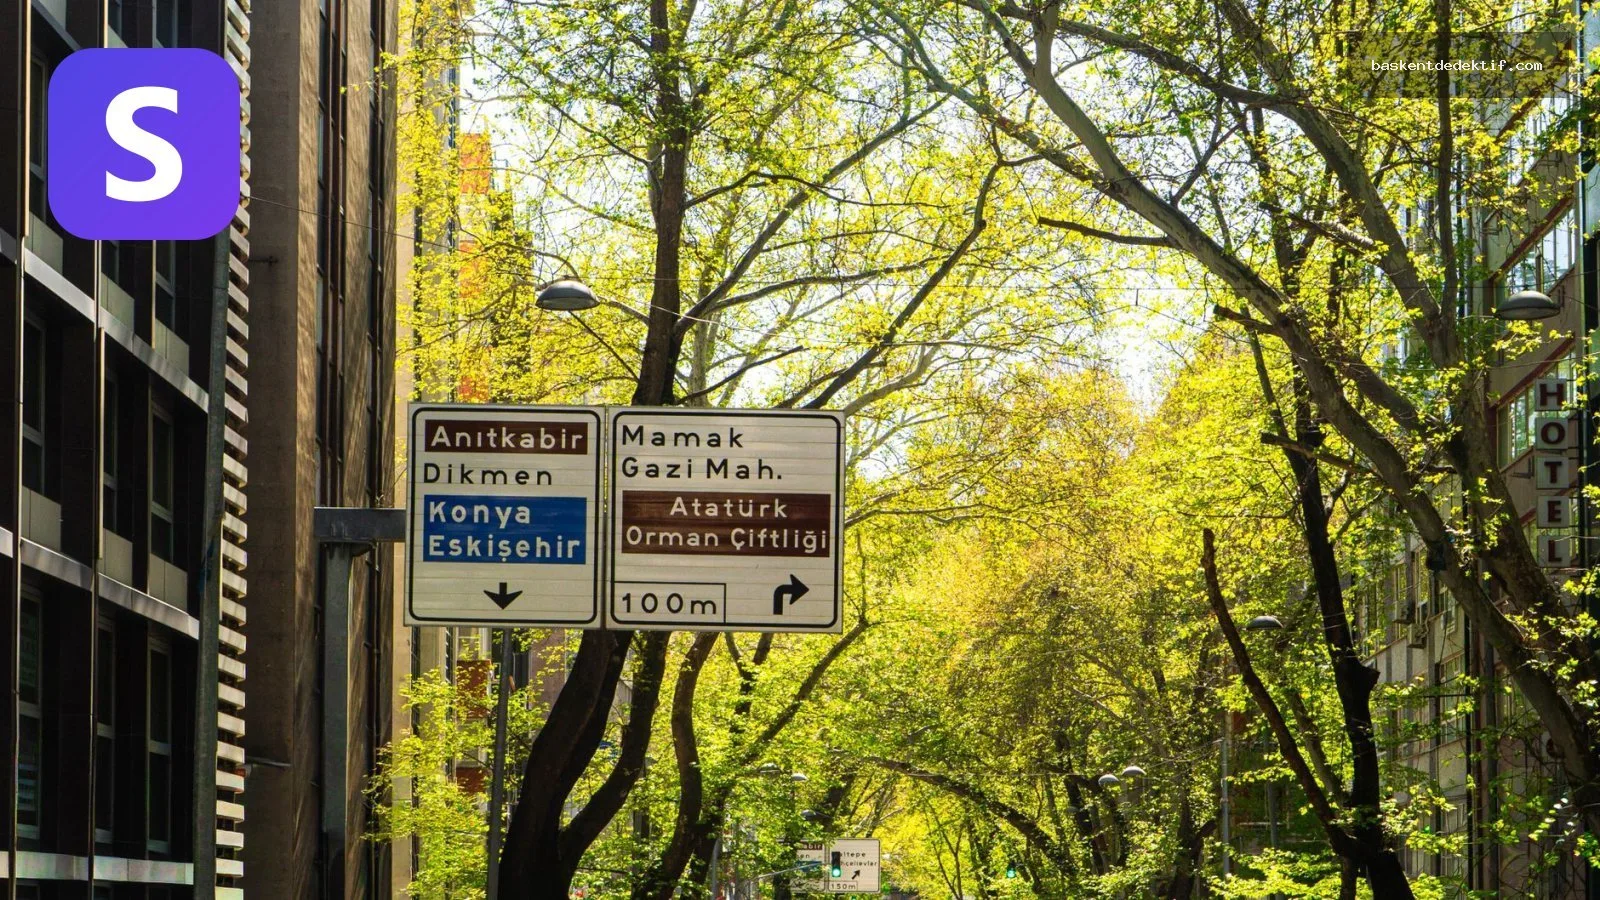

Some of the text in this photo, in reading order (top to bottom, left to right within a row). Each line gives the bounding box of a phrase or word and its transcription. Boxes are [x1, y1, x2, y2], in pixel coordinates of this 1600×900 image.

[431, 426, 583, 450] Anıtkabir
[622, 424, 744, 448] Mamak
[424, 463, 552, 485] Dikmen
[621, 457, 782, 480] Gazi Mah.
[1540, 384, 1563, 562] HOTEL
[429, 501, 530, 528] Konya
[670, 497, 787, 518] Atatürk
[429, 535, 580, 562] Eskişehir
[626, 526, 827, 553] Orman Çiftliği
[622, 593, 717, 615] 100m
